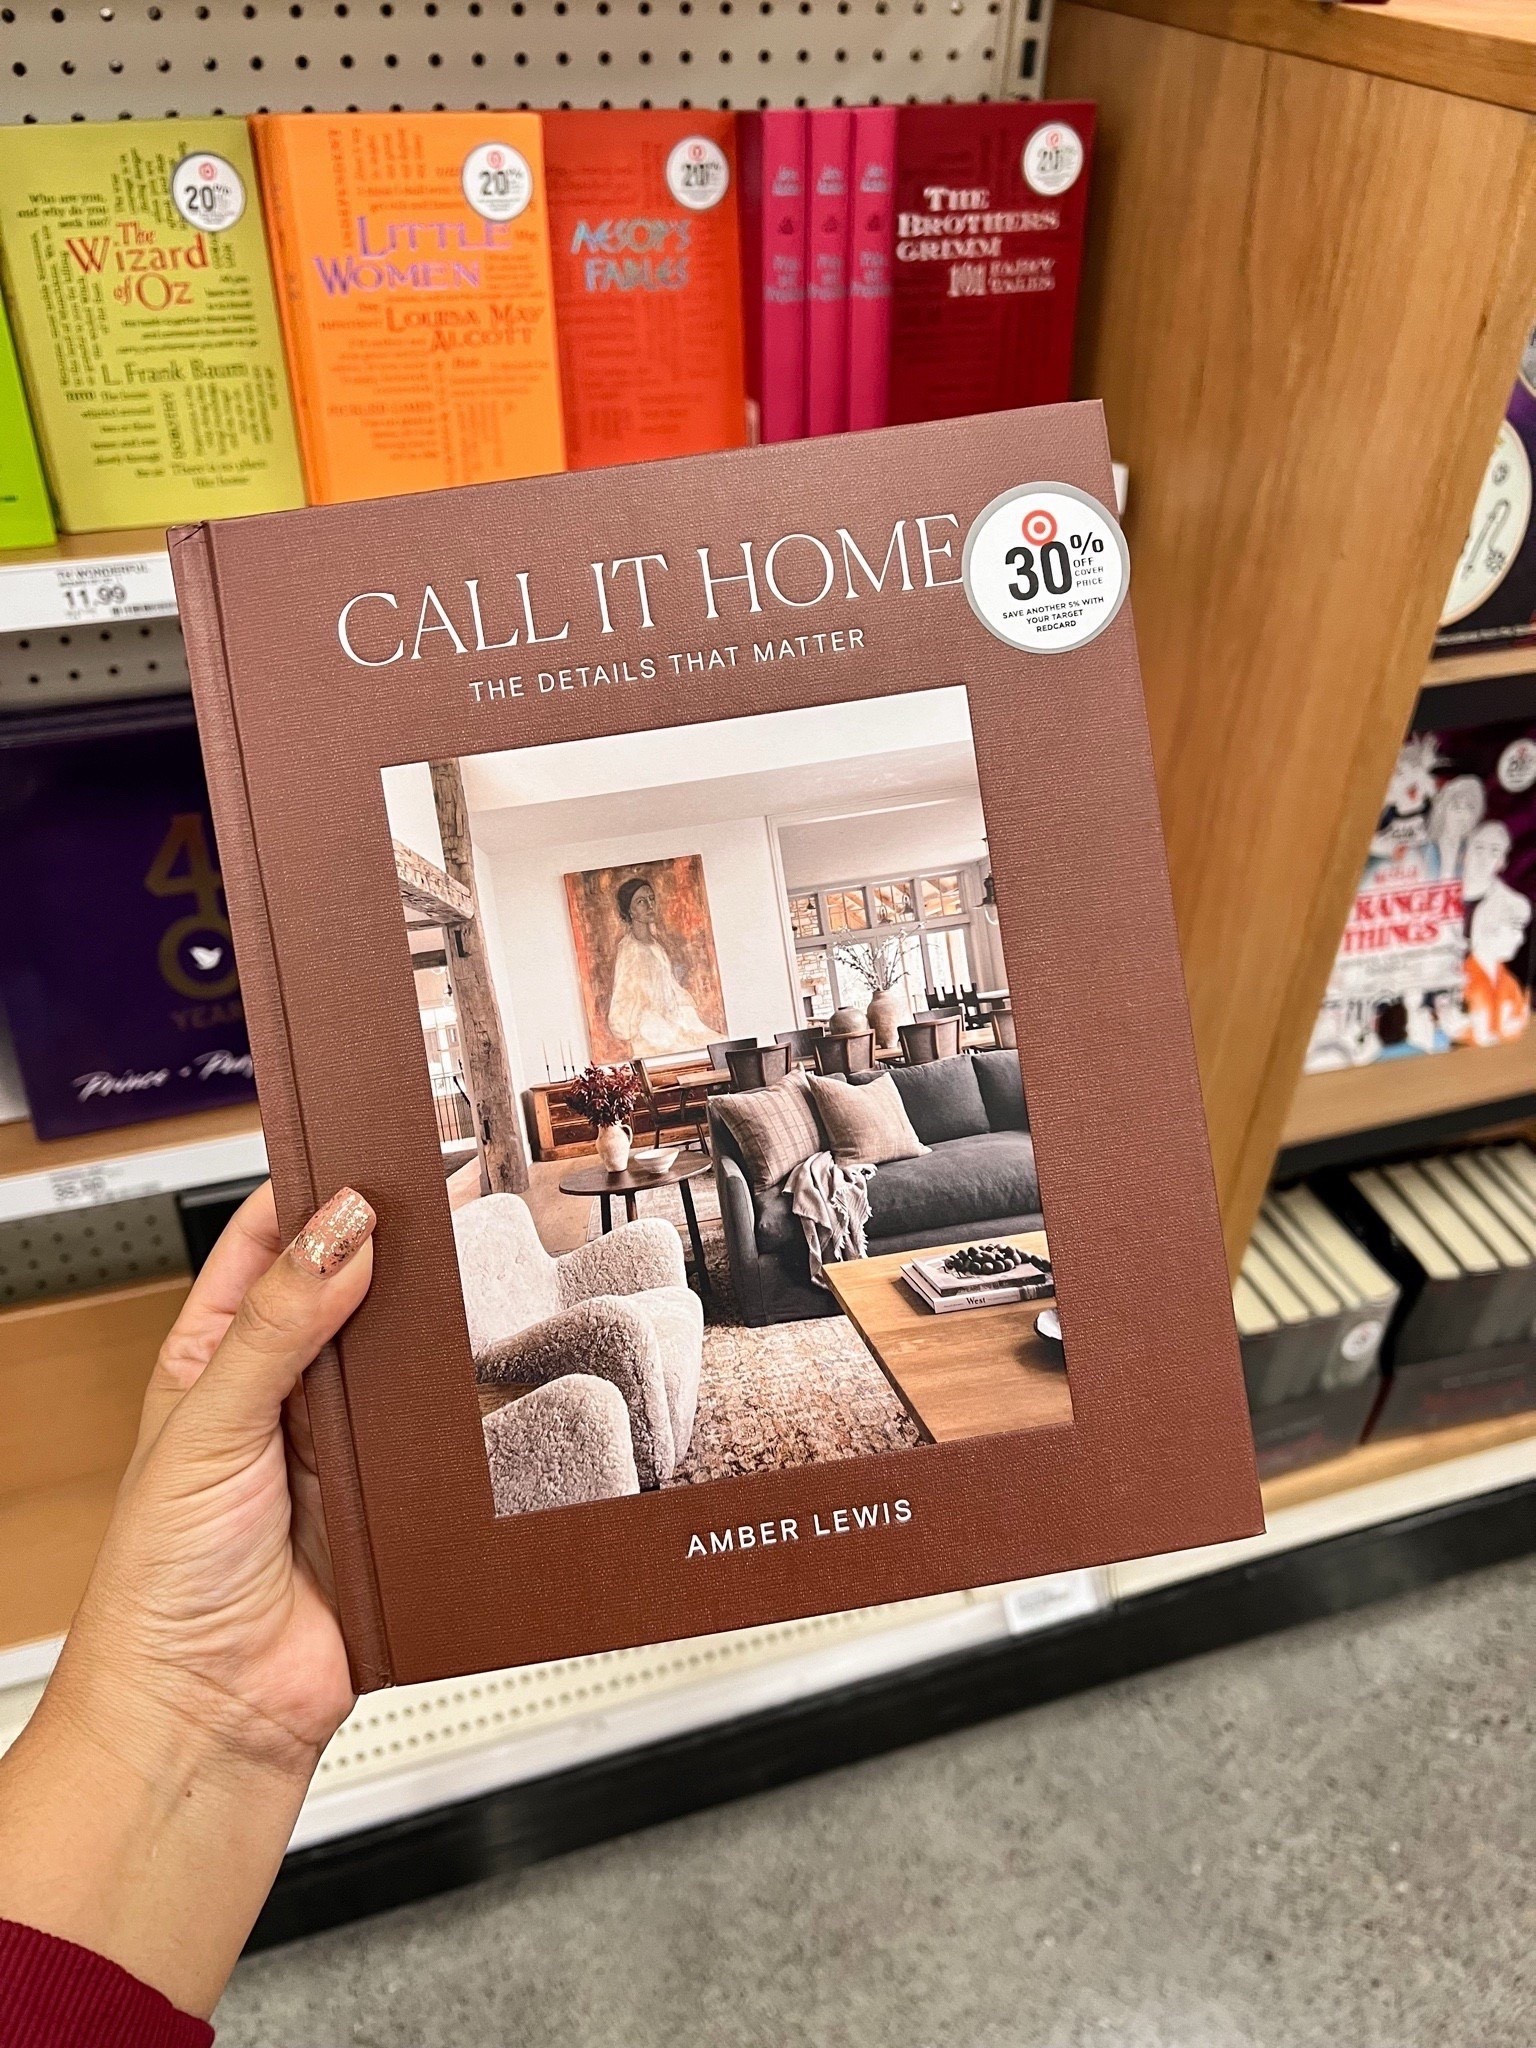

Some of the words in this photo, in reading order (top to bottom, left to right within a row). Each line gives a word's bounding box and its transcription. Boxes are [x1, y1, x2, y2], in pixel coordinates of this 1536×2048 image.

[115, 220, 156, 246] The
[356, 215, 512, 260] LITTLE
[898, 210, 1061, 238] BROTHERS
[65, 232, 210, 274] Wizard
[896, 237, 1003, 263] GRIMM
[313, 255, 480, 297] WOMEN
[113, 274, 132, 307] of
[135, 272, 196, 312] Oz
[124, 358, 186, 384] Frank
[1004, 531, 1105, 602] 30%
[1073, 556, 1095, 568] OFF
[1074, 566, 1104, 577] COVER
[337, 571, 570, 668] CALL
[590, 553, 670, 635] IT
[696, 512, 964, 620] HOME
[1076, 576, 1103, 588] PRICE
[64, 584, 127, 610] 11.99
[1002, 609, 1024, 619] SAVE
[1026, 602, 1067, 616] ANOTHER
[1068, 600, 1080, 608] 5%
[1081, 596, 1104, 607] WITH
[1026, 615, 1050, 625] YOUR
[1051, 609, 1084, 621] TARGET
[1036, 620, 1077, 633] REDCARD
[469, 675, 525, 703] THE
[537, 657, 657, 695] DETAILS
[668, 646, 739, 675] THAT
[752, 628, 866, 664] MATTER
[1355, 884, 1466, 921] RANGER
[72, 1067, 170, 1104] Prince
[966, 1296, 987, 1306] West
[685, 1517, 800, 1559] AMBER
[813, 1498, 913, 1538] LEWIS
